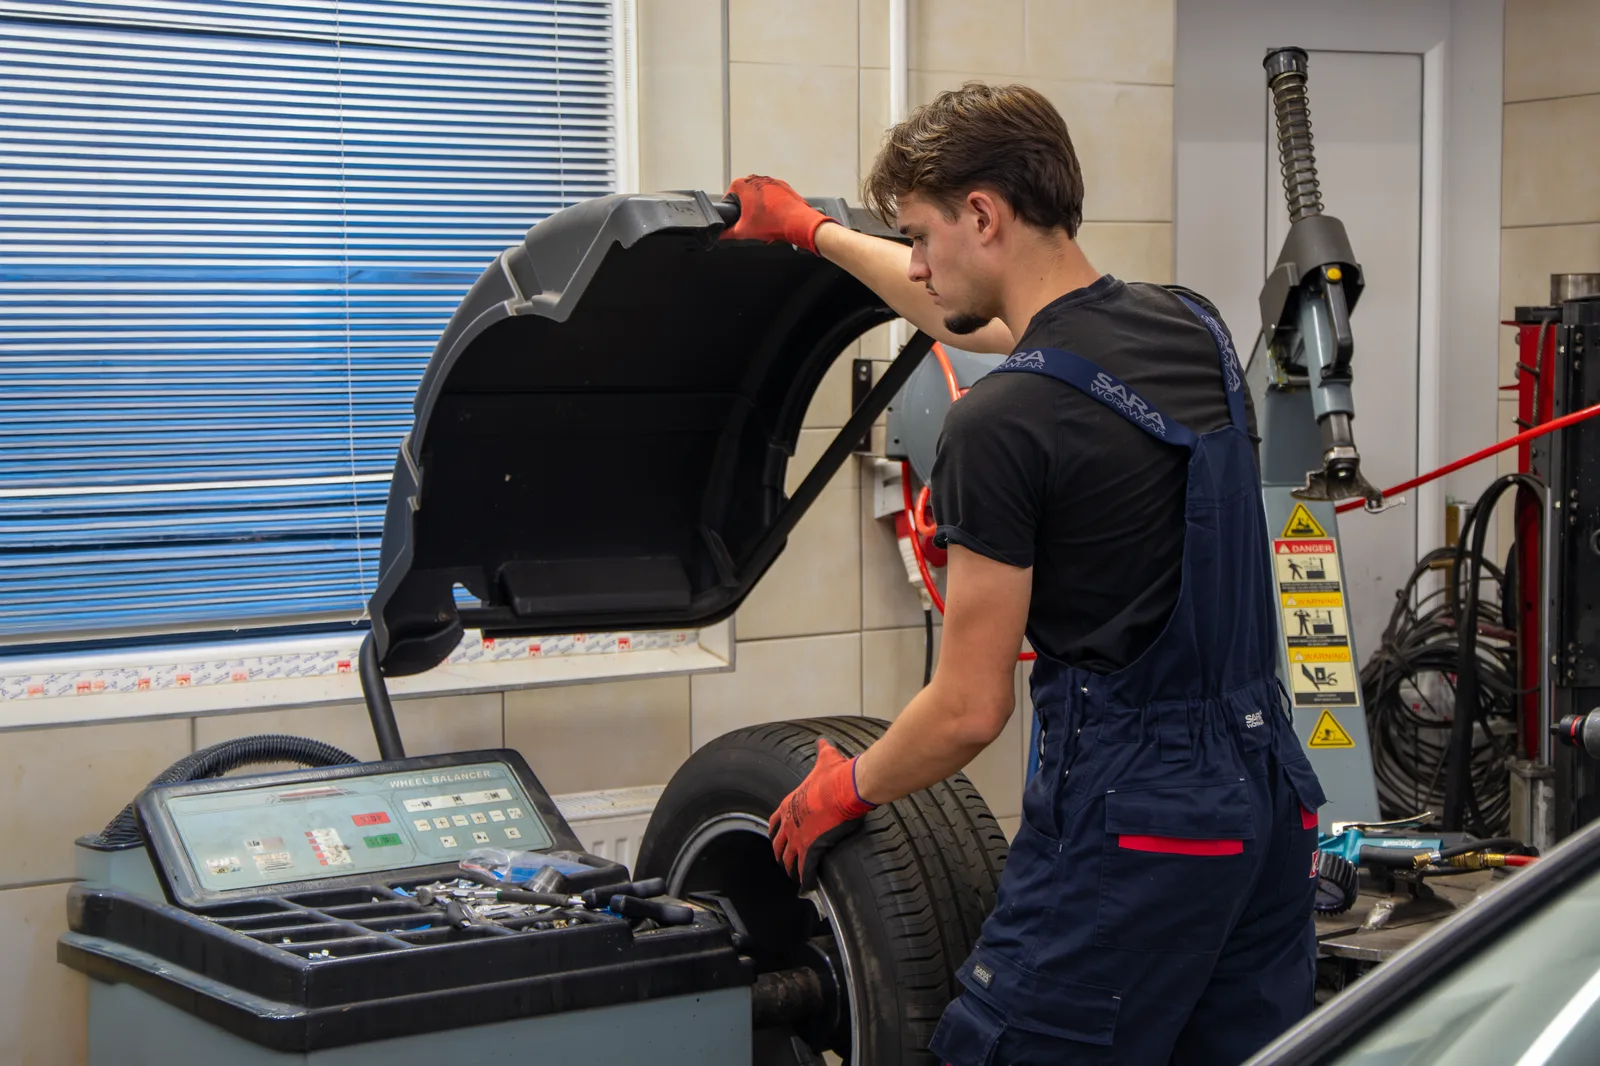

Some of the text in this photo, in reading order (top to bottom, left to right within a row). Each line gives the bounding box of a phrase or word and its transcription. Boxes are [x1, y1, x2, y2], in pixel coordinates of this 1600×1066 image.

[1006, 350, 1045, 363] RA
[1093, 372, 1166, 430] SARA
[1091, 383, 1165, 436] WORKWEAR
[1292, 544, 1332, 553] DANGER
[1304, 652, 1348, 660] WARNING
[390, 770, 491, 788] WHEEL BALANCER
